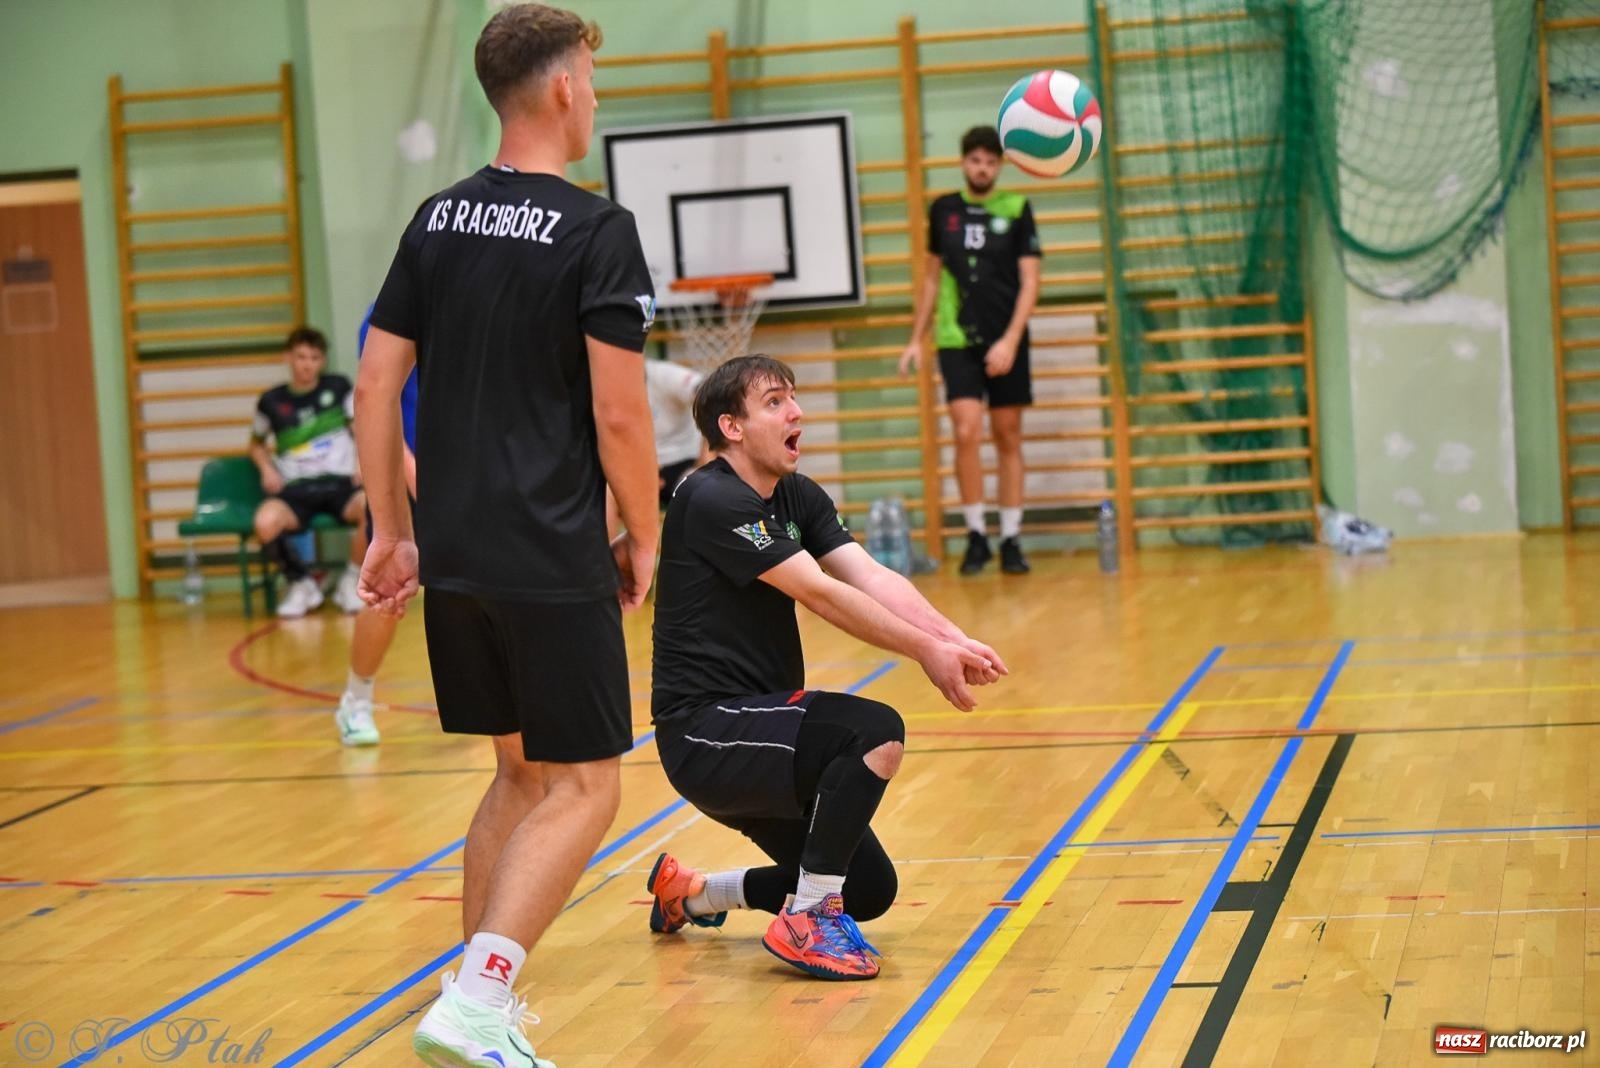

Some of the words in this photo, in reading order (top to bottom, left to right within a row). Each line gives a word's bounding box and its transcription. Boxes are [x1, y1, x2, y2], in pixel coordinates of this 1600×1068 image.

[427, 199, 453, 232] KS
[452, 199, 562, 245] RACIBÓRZ
[753, 535, 772, 548] PCS
[485, 953, 512, 980] R
